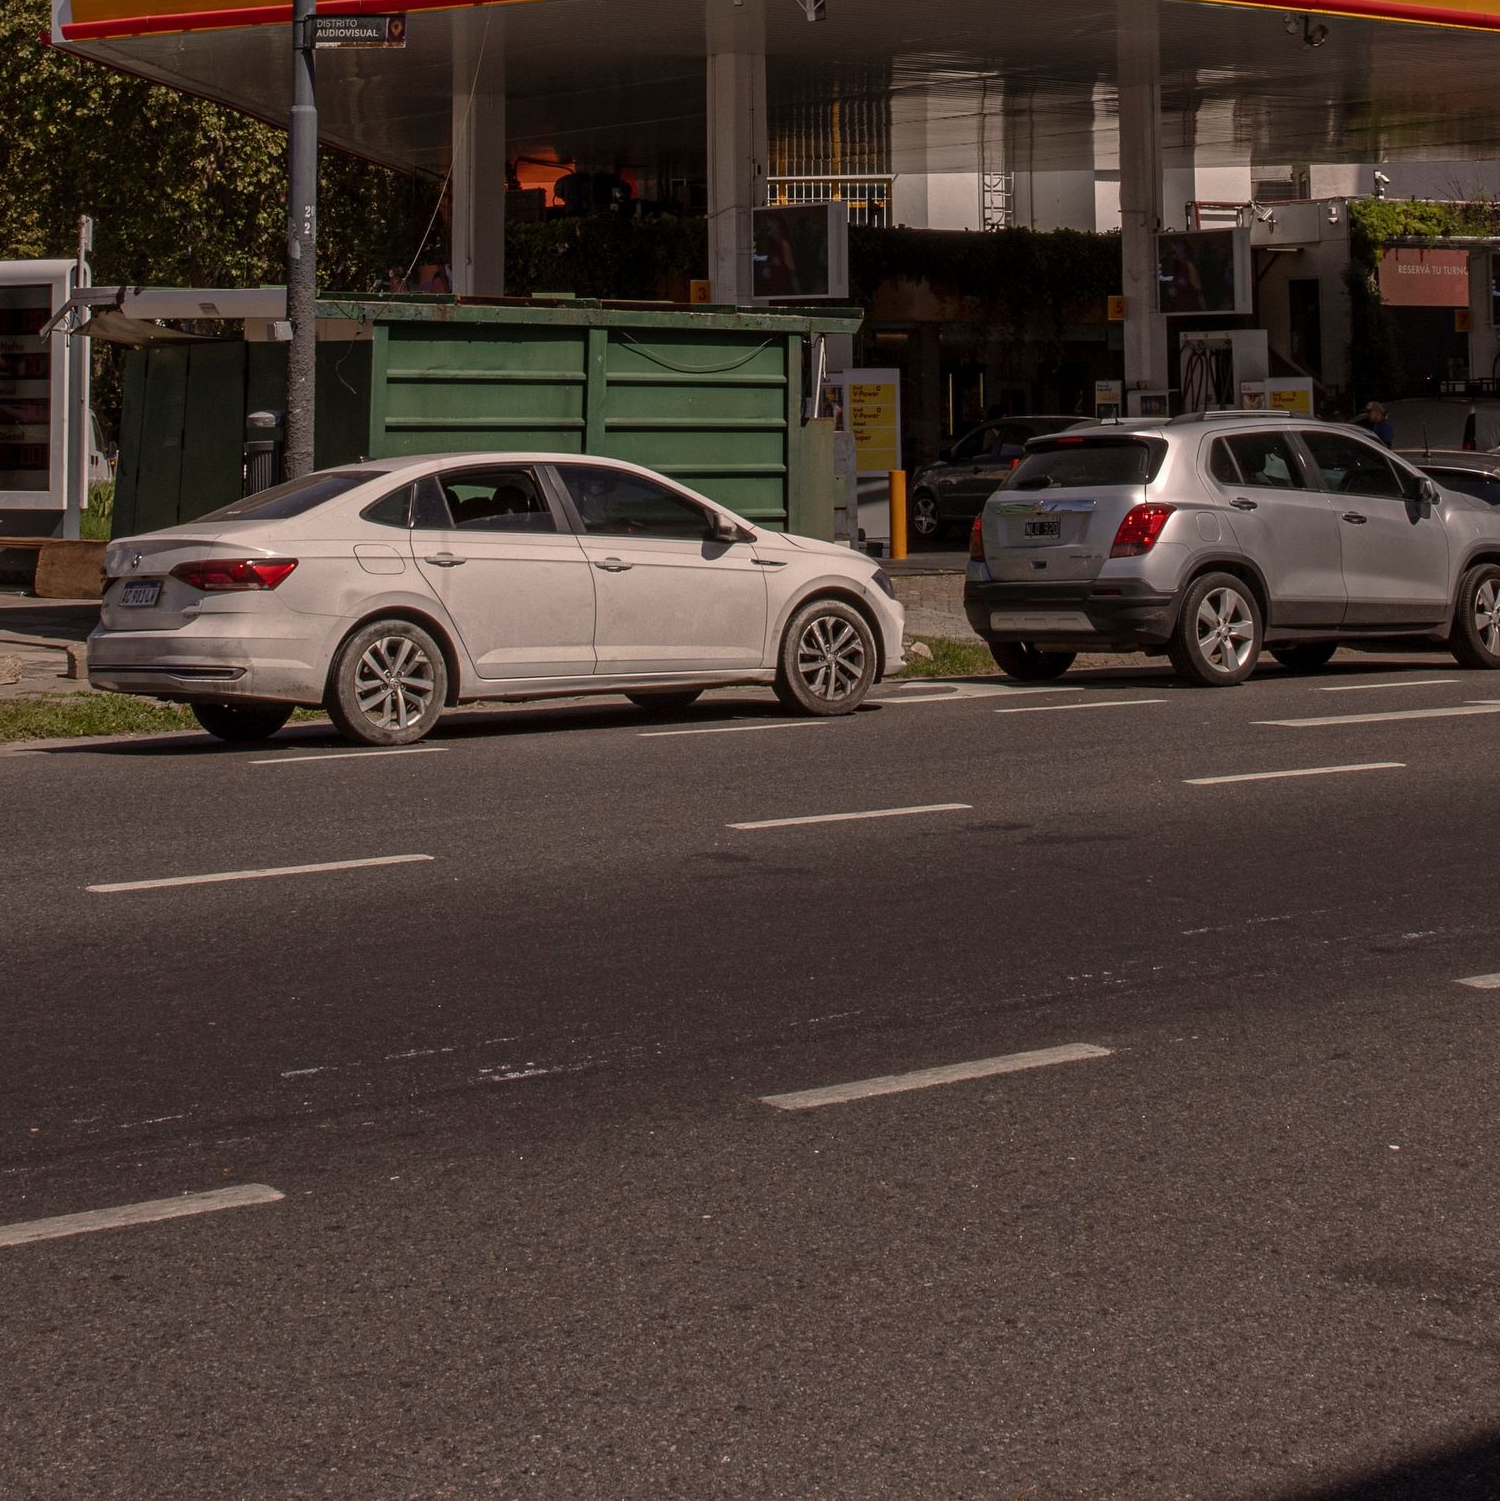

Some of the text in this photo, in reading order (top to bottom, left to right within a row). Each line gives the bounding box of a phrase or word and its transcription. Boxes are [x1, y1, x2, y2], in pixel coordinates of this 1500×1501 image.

[316, 19, 357, 28] DISTRITO
[316, 29, 378, 37] AUDIOVISUAL
[1432, 266, 1442, 275] TU
[698, 286, 707, 301] 3
[1115, 301, 1123, 314] 5
[0, 430, 25, 441] Diesel
